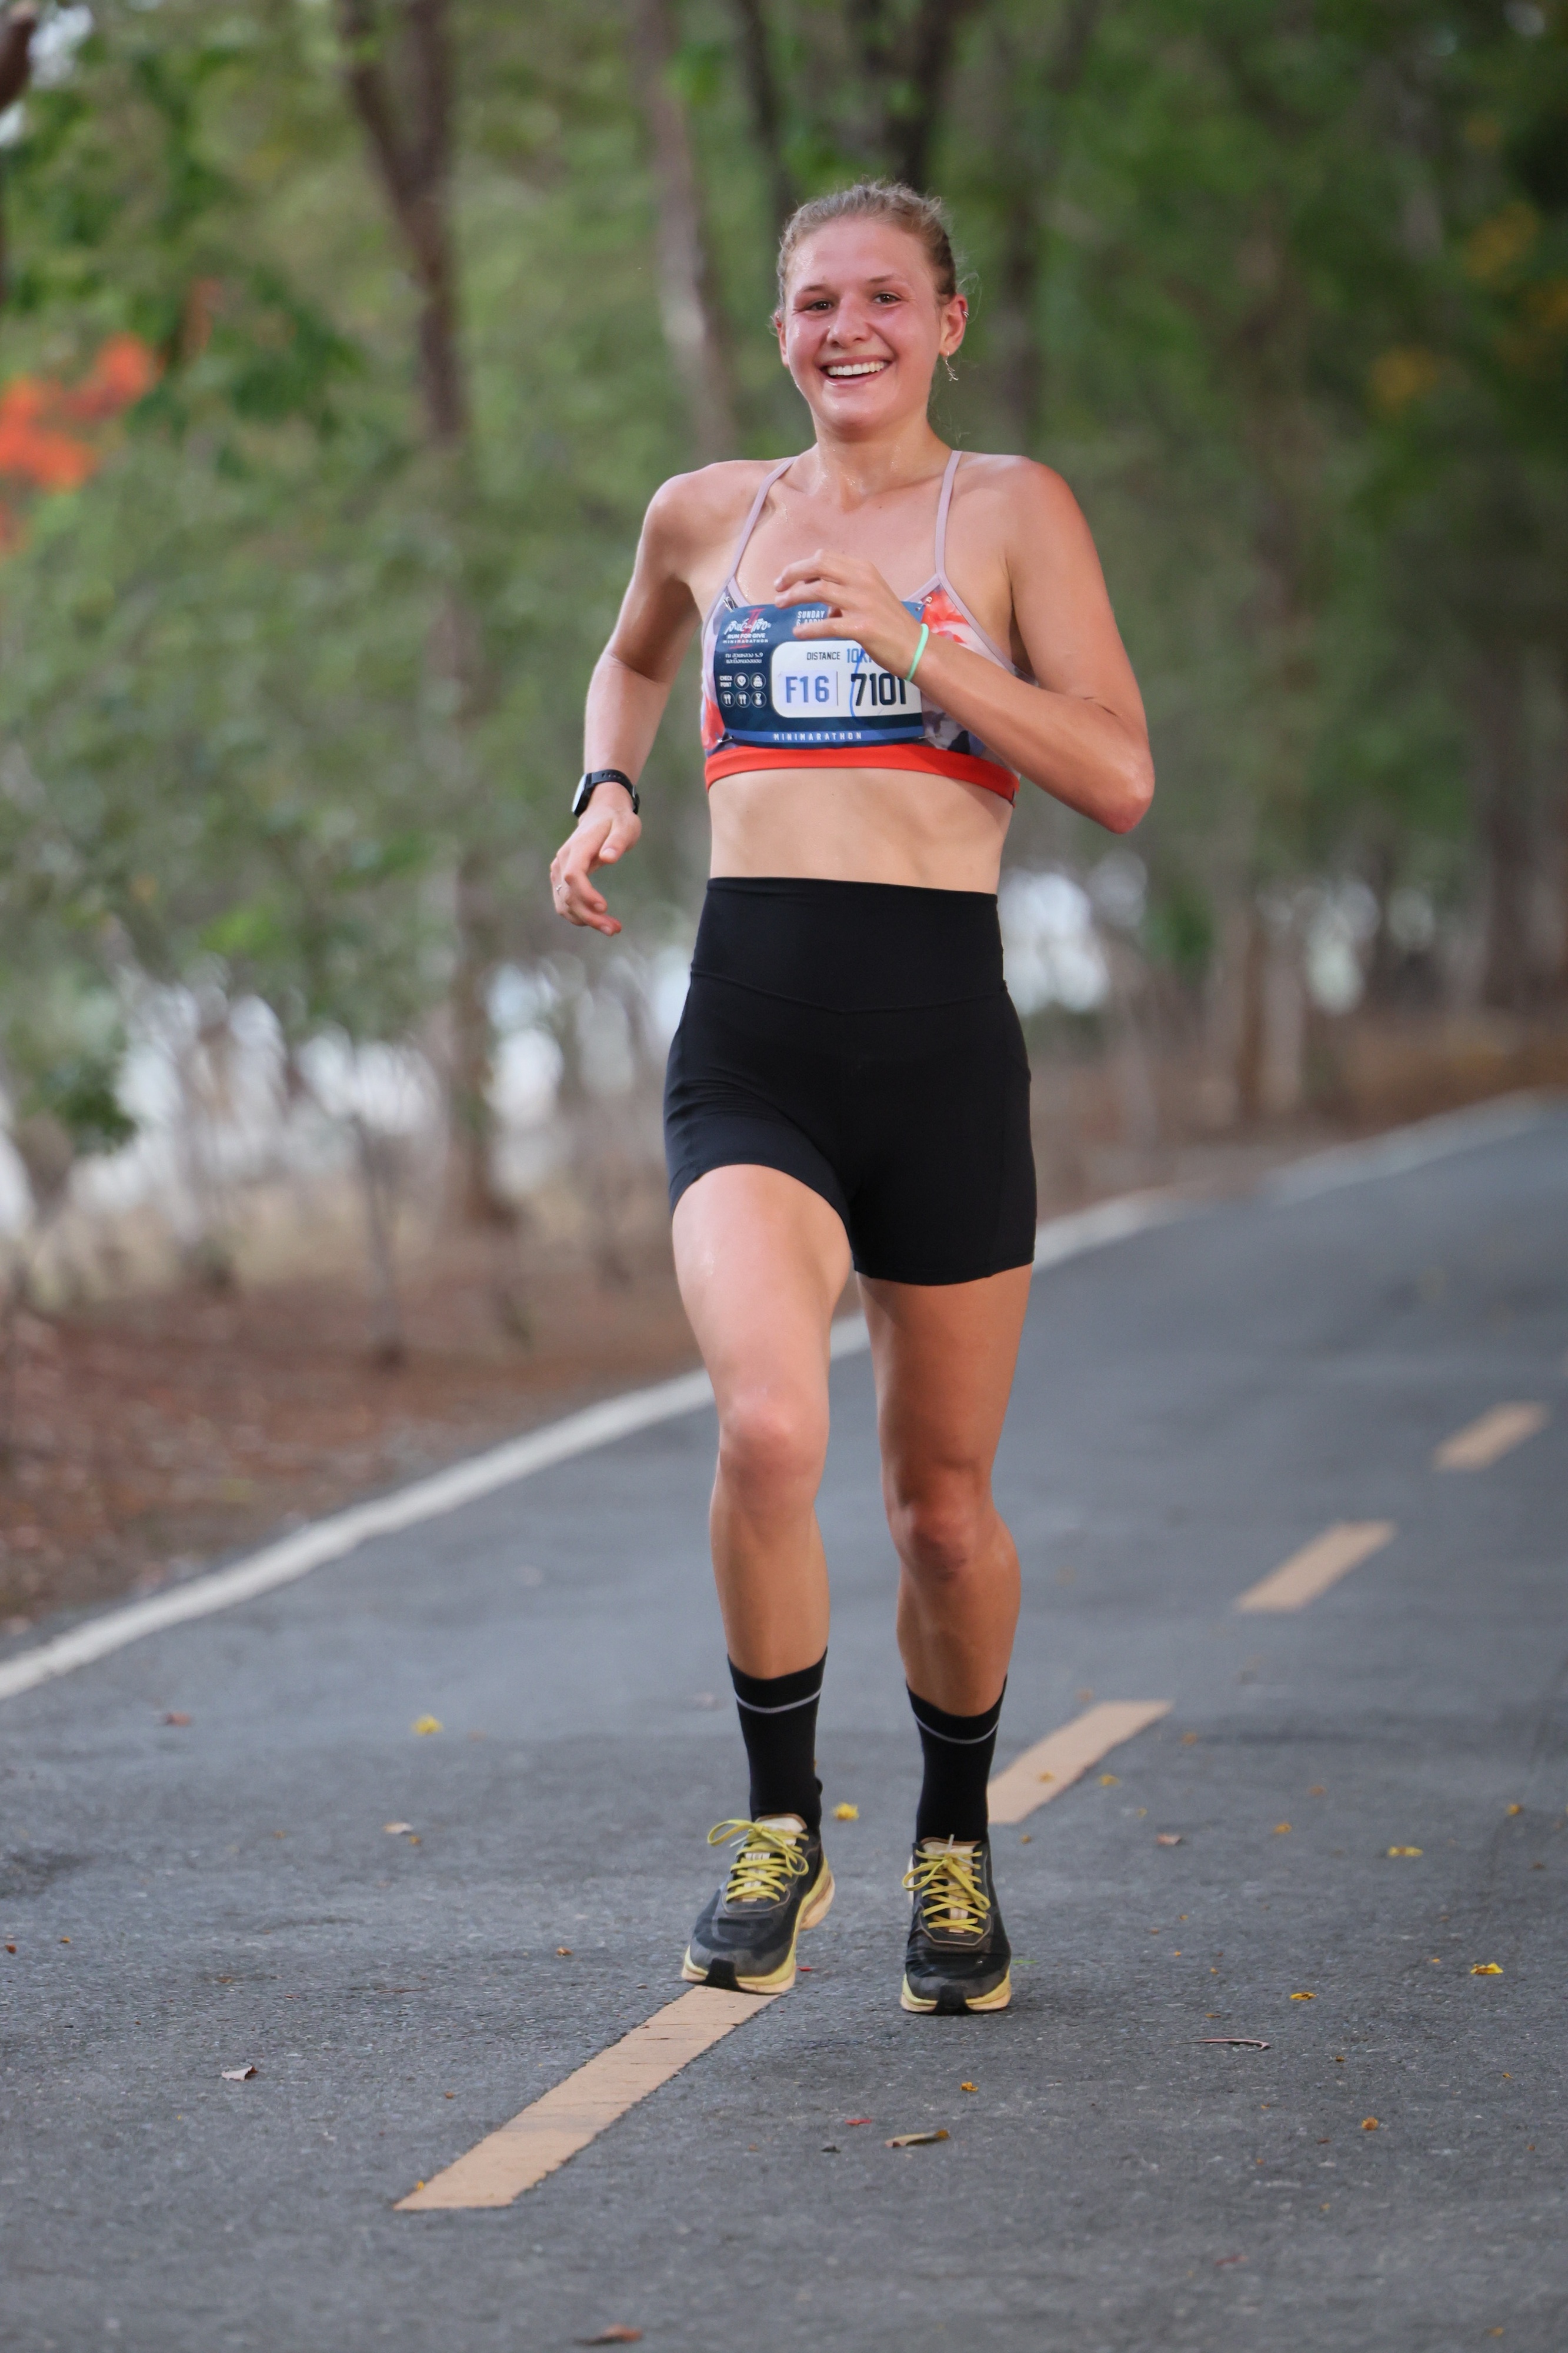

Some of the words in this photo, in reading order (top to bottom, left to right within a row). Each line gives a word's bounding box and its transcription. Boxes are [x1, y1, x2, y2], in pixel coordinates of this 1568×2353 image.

[797, 610, 825, 619] SUNDAY
[806, 651, 840, 661] DISTANCE
[786, 675, 830, 703] F16
[850, 672, 907, 706] 7101
[773, 731, 862, 741] MINIMARATHON
